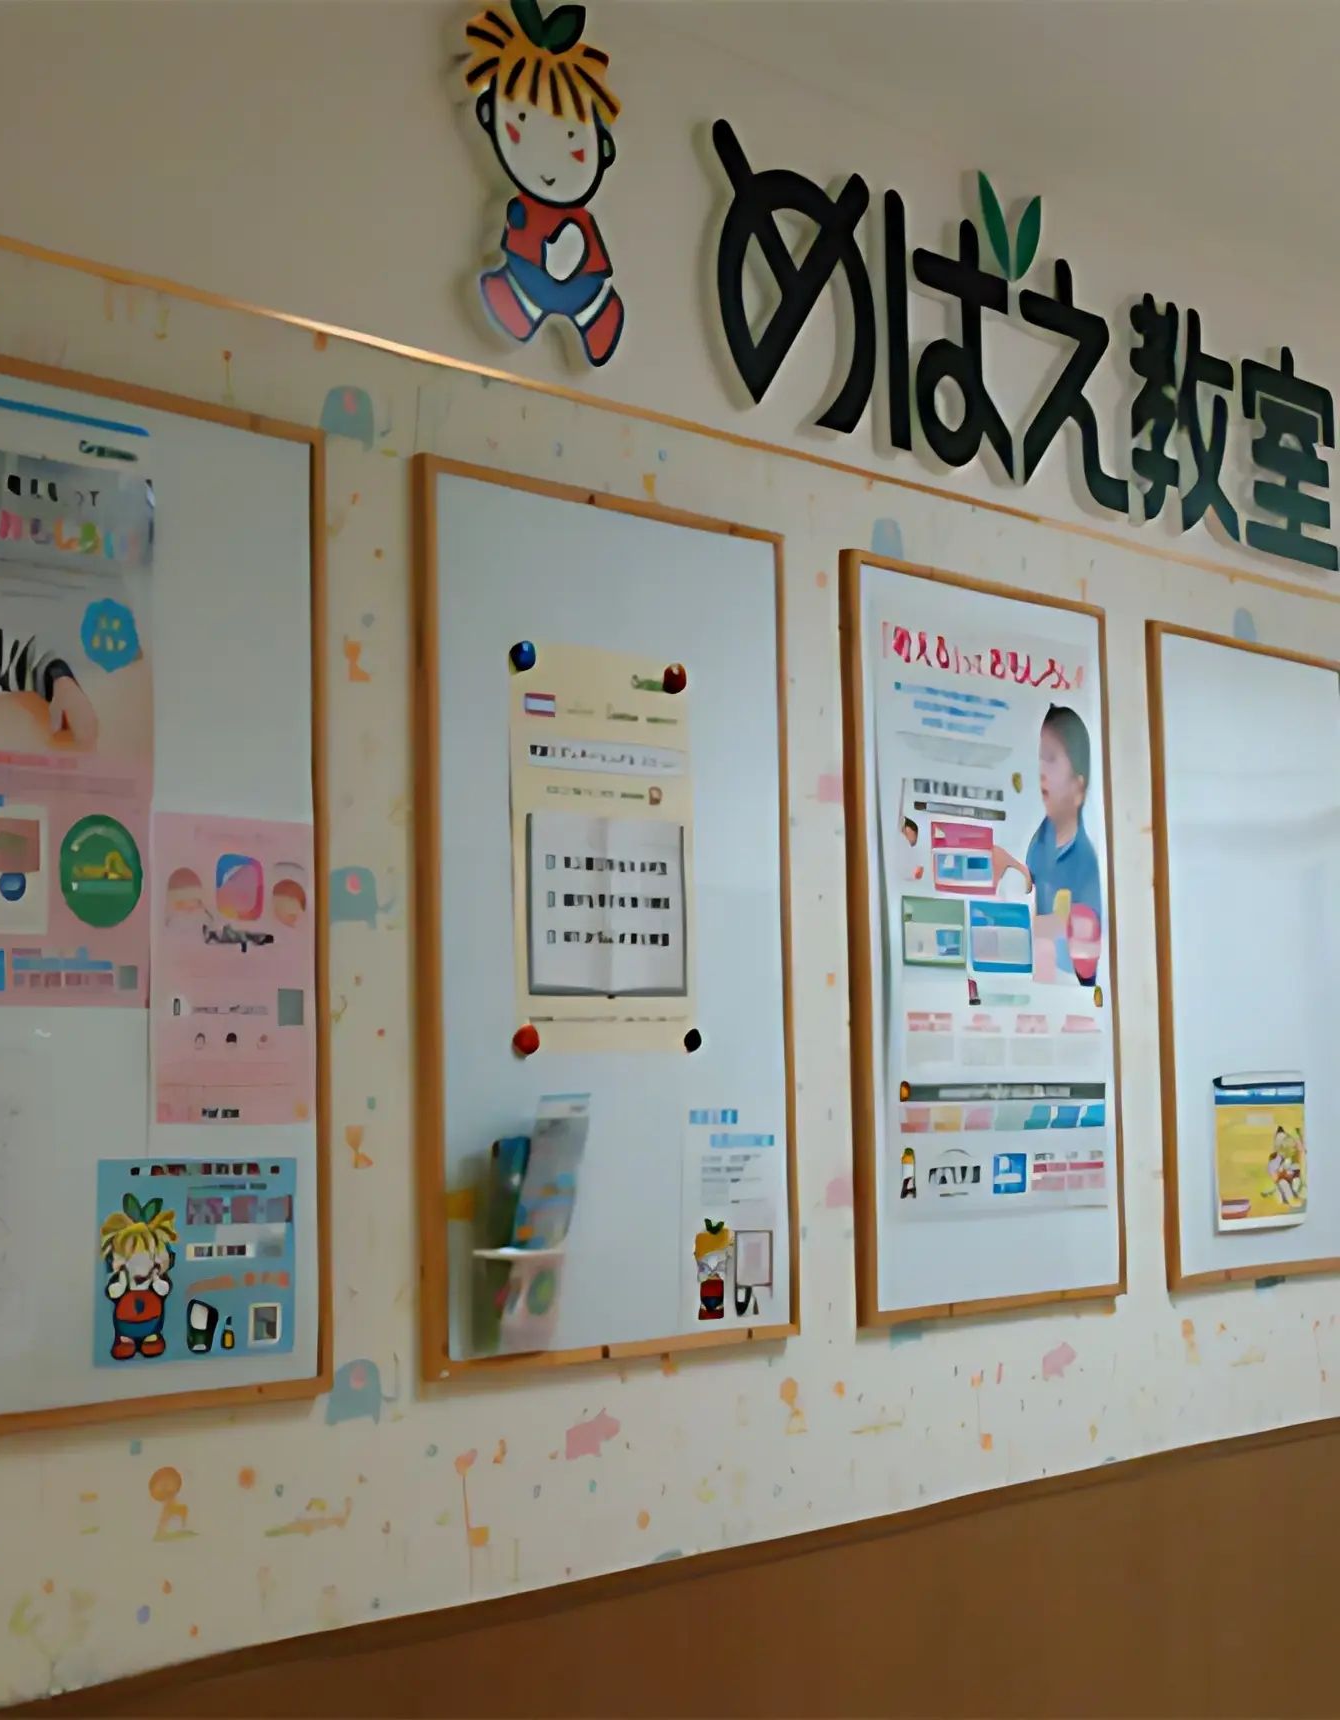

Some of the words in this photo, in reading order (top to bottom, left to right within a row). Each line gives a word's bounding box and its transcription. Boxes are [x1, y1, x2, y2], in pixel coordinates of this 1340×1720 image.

[712, 117, 1340, 571] めばえ教室
